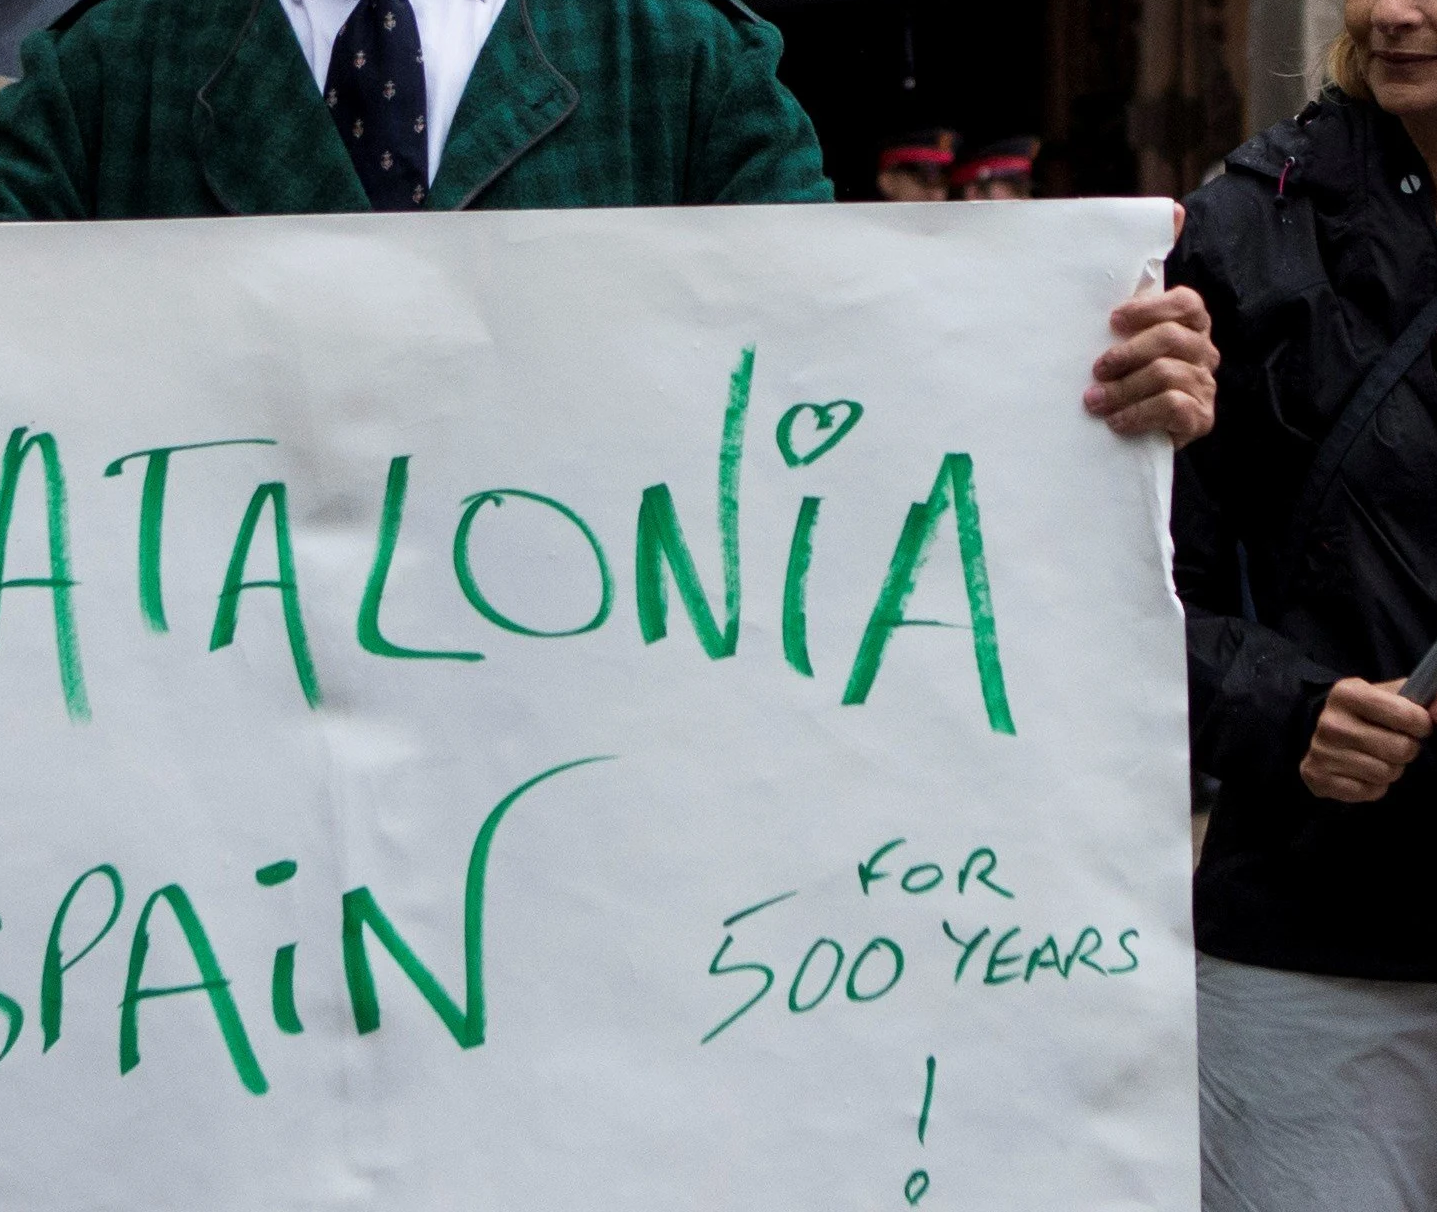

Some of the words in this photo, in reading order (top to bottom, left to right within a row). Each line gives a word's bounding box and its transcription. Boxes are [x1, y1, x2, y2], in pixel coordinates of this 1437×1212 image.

[858, 838, 1013, 899] FOR
[700, 892, 905, 1045] 500
[939, 922, 1138, 986] YEARS
[904, 1056, 937, 1206] !
